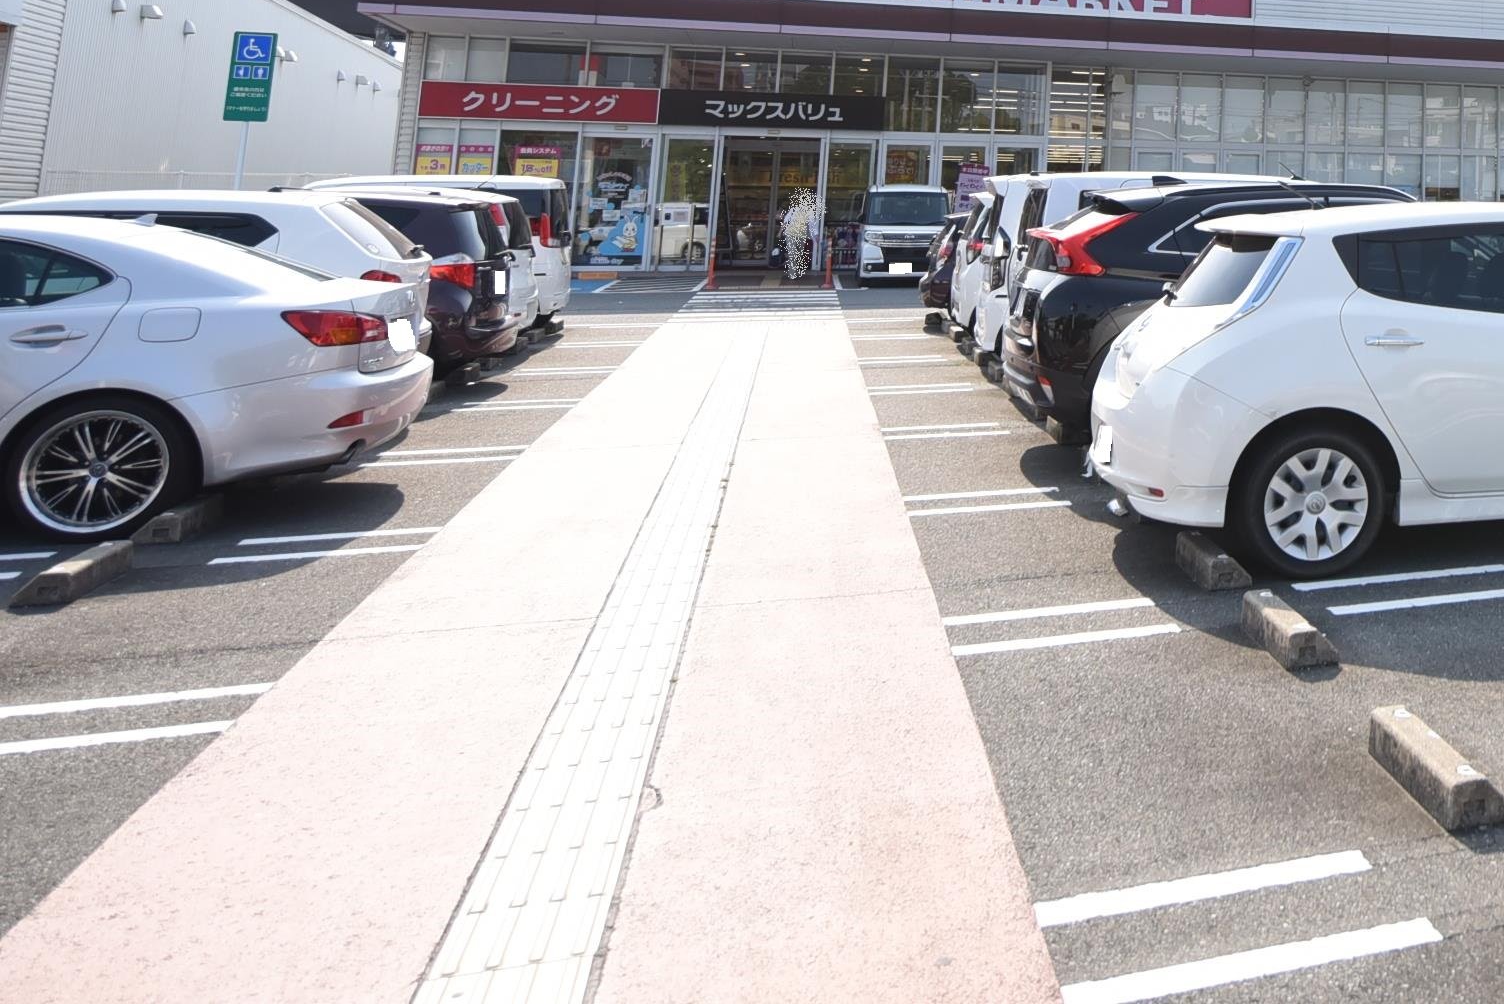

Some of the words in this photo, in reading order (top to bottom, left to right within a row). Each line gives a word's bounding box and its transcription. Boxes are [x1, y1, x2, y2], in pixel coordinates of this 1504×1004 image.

[462, 90, 620, 116] クリーニング
[704, 99, 844, 122] マックスバリュ
